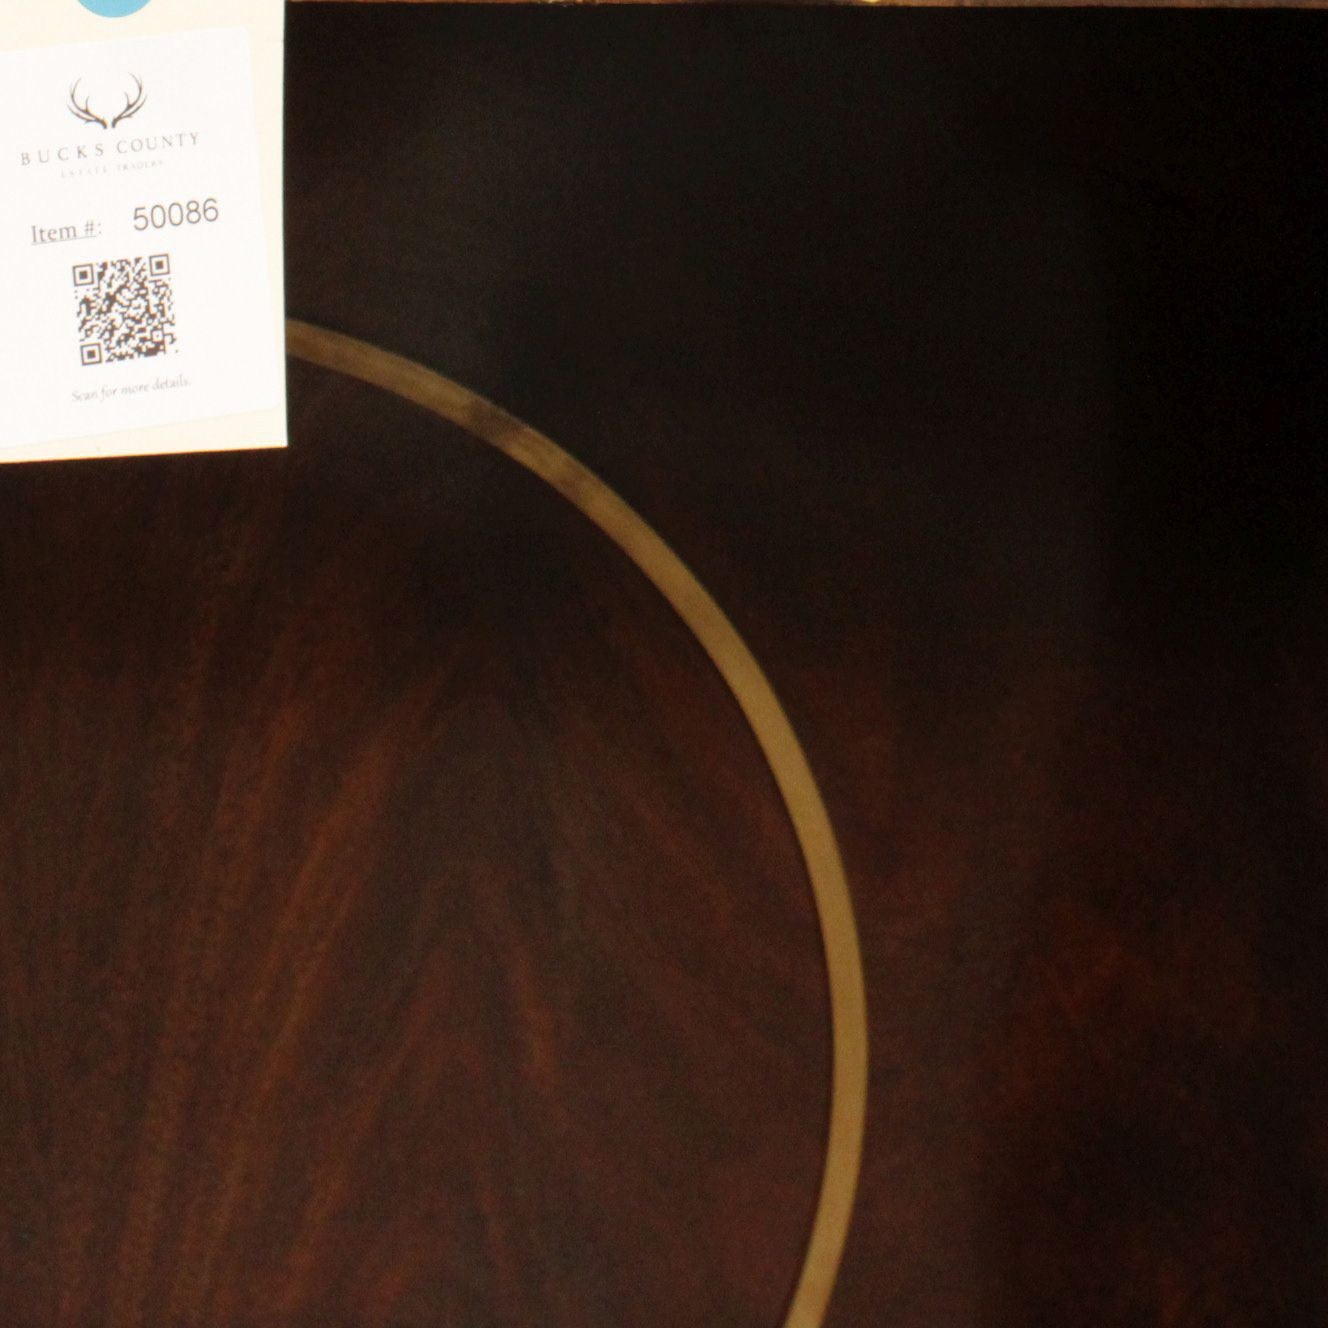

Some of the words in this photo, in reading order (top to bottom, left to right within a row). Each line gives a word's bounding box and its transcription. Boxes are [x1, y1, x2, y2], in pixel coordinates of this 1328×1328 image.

[21, 142, 105, 167] BUCKS
[116, 131, 200, 155] COUNTY
[31, 223, 77, 244] Item
[133, 198, 219, 232] 50086
[99, 383, 117, 403] for
[120, 383, 149, 395] more
